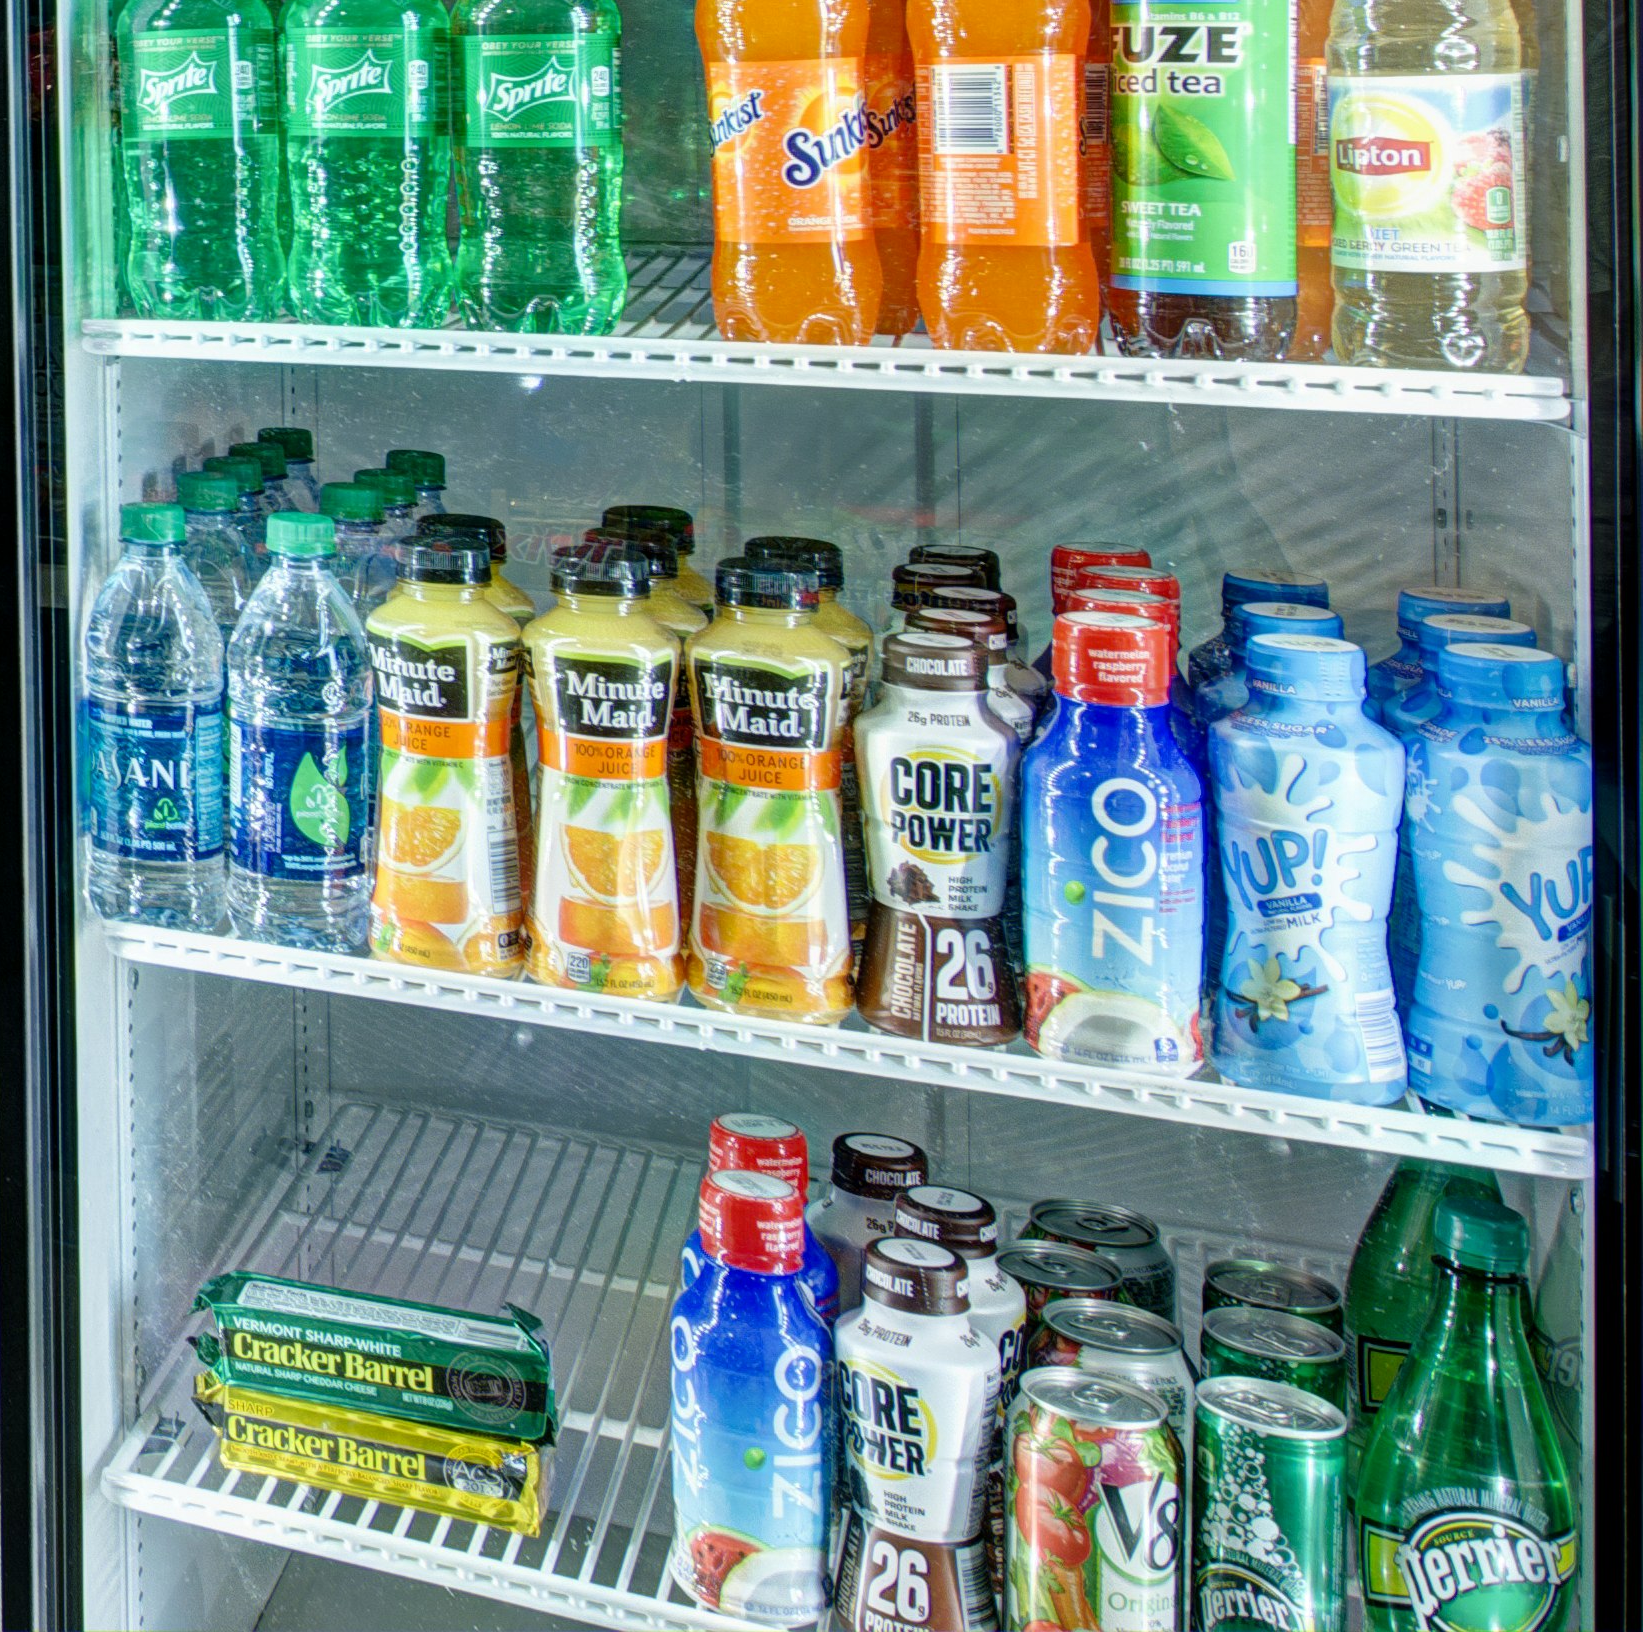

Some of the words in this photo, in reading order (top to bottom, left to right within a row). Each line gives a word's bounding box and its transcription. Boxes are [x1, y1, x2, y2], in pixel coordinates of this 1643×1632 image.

[143, 62, 208, 106] Sprite
[314, 60, 383, 105] Sprite
[593, 70, 608, 82] 240
[1115, 68, 1158, 94] iced
[1166, 70, 1222, 95] tea
[492, 67, 568, 114] Sprite
[782, 88, 867, 190] Sunki
[1338, 142, 1422, 171] Lipton
[1121, 200, 1166, 216] SWEET
[1168, 202, 1202, 217] TEA
[1391, 241, 1441, 254] GREEN
[370, 642, 457, 683] Minute
[905, 654, 969, 677] CHOCOLATE
[1088, 647, 1150, 660] watermelon
[1093, 660, 1147, 673] raspberry
[1097, 671, 1145, 684] flavored
[378, 671, 444, 709] Maid
[566, 669, 665, 701] Minute
[702, 670, 820, 711] Minute
[1252, 678, 1297, 695] VANILLA
[580, 698, 653, 729] Maid
[1512, 697, 1559, 709] VANILLA
[720, 703, 805, 738] Maid
[929, 712, 971, 728] PROTEIN
[393, 735, 428, 752] JUICE
[597, 761, 637, 776] JUICE
[738, 769, 783, 785] JUICE
[890, 755, 994, 814] CORE
[890, 811, 993, 854] POWER
[948, 875, 973, 885] HIGH
[1091, 777, 1158, 965] ZICO
[1221, 827, 1329, 911] YUP!
[948, 885, 988, 895] PROTEIN
[948, 894, 973, 903] MILK
[1265, 895, 1308, 910] VANILLA
[1499, 844, 1593, 942] YUP
[948, 903, 979, 912] SHAKE
[1286, 912, 1322, 930] MILK
[569, 954, 590, 969] 220
[890, 921, 917, 1020] CHOCOLATE
[935, 1002, 1002, 1027] PROTEIN
[865, 1168, 923, 1187] CHOCOLATE
[894, 1208, 941, 1241] CHOCOLATE
[865, 1263, 915, 1298] CHOCOLATE
[233, 1315, 304, 1341] VERMONT
[305, 1329, 402, 1359] SHARP-WHITE
[871, 1324, 913, 1349] PROTEIN
[233, 1331, 341, 1376] Cracker
[344, 1351, 435, 1394] Barrel
[234, 1360, 273, 1377] NATURAL
[344, 1382, 378, 1398] CHEESE
[227, 1398, 275, 1418] SHARP
[836, 1357, 923, 1439] CORE
[772, 1344, 822, 1518] ZICO
[227, 1415, 335, 1461] Cracker
[336, 1436, 427, 1481] Barrel
[882, 1488, 908, 1504] HIGH
[883, 1498, 927, 1517] PROTEIN
[1431, 1486, 1480, 1508] NATURAL
[884, 1508, 908, 1523] MILK
[1096, 1470, 1181, 1572] V8
[1432, 1528, 1476, 1547] SOURCE
[1393, 1522, 1563, 1632] Perrier
